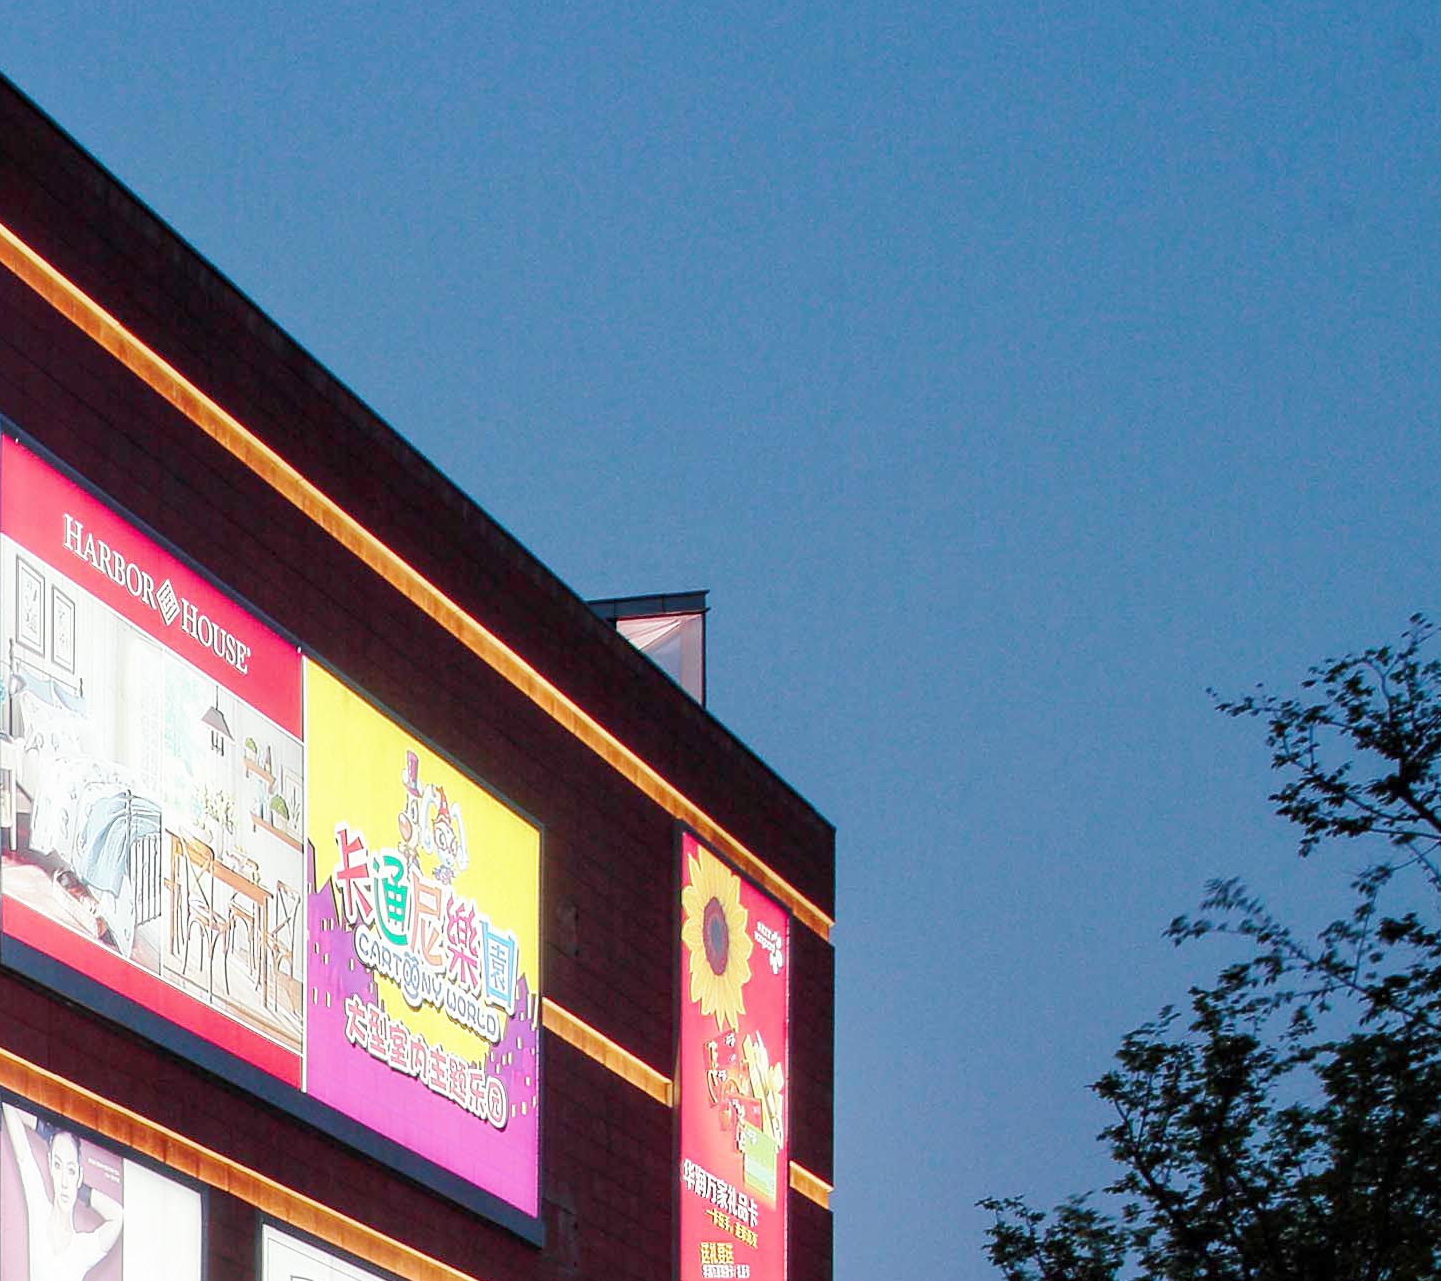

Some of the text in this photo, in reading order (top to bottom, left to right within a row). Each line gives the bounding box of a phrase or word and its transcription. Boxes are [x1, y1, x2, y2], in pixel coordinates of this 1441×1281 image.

[62, 513, 248, 674] HARBOR HOUSE
[336, 826, 516, 1010] 卡通尼樂園
[346, 1001, 506, 1123] 大型室内主题乐园
[446, 988, 498, 1037] WORLD
[682, 1158, 759, 1227] 华润万家礼品卡
